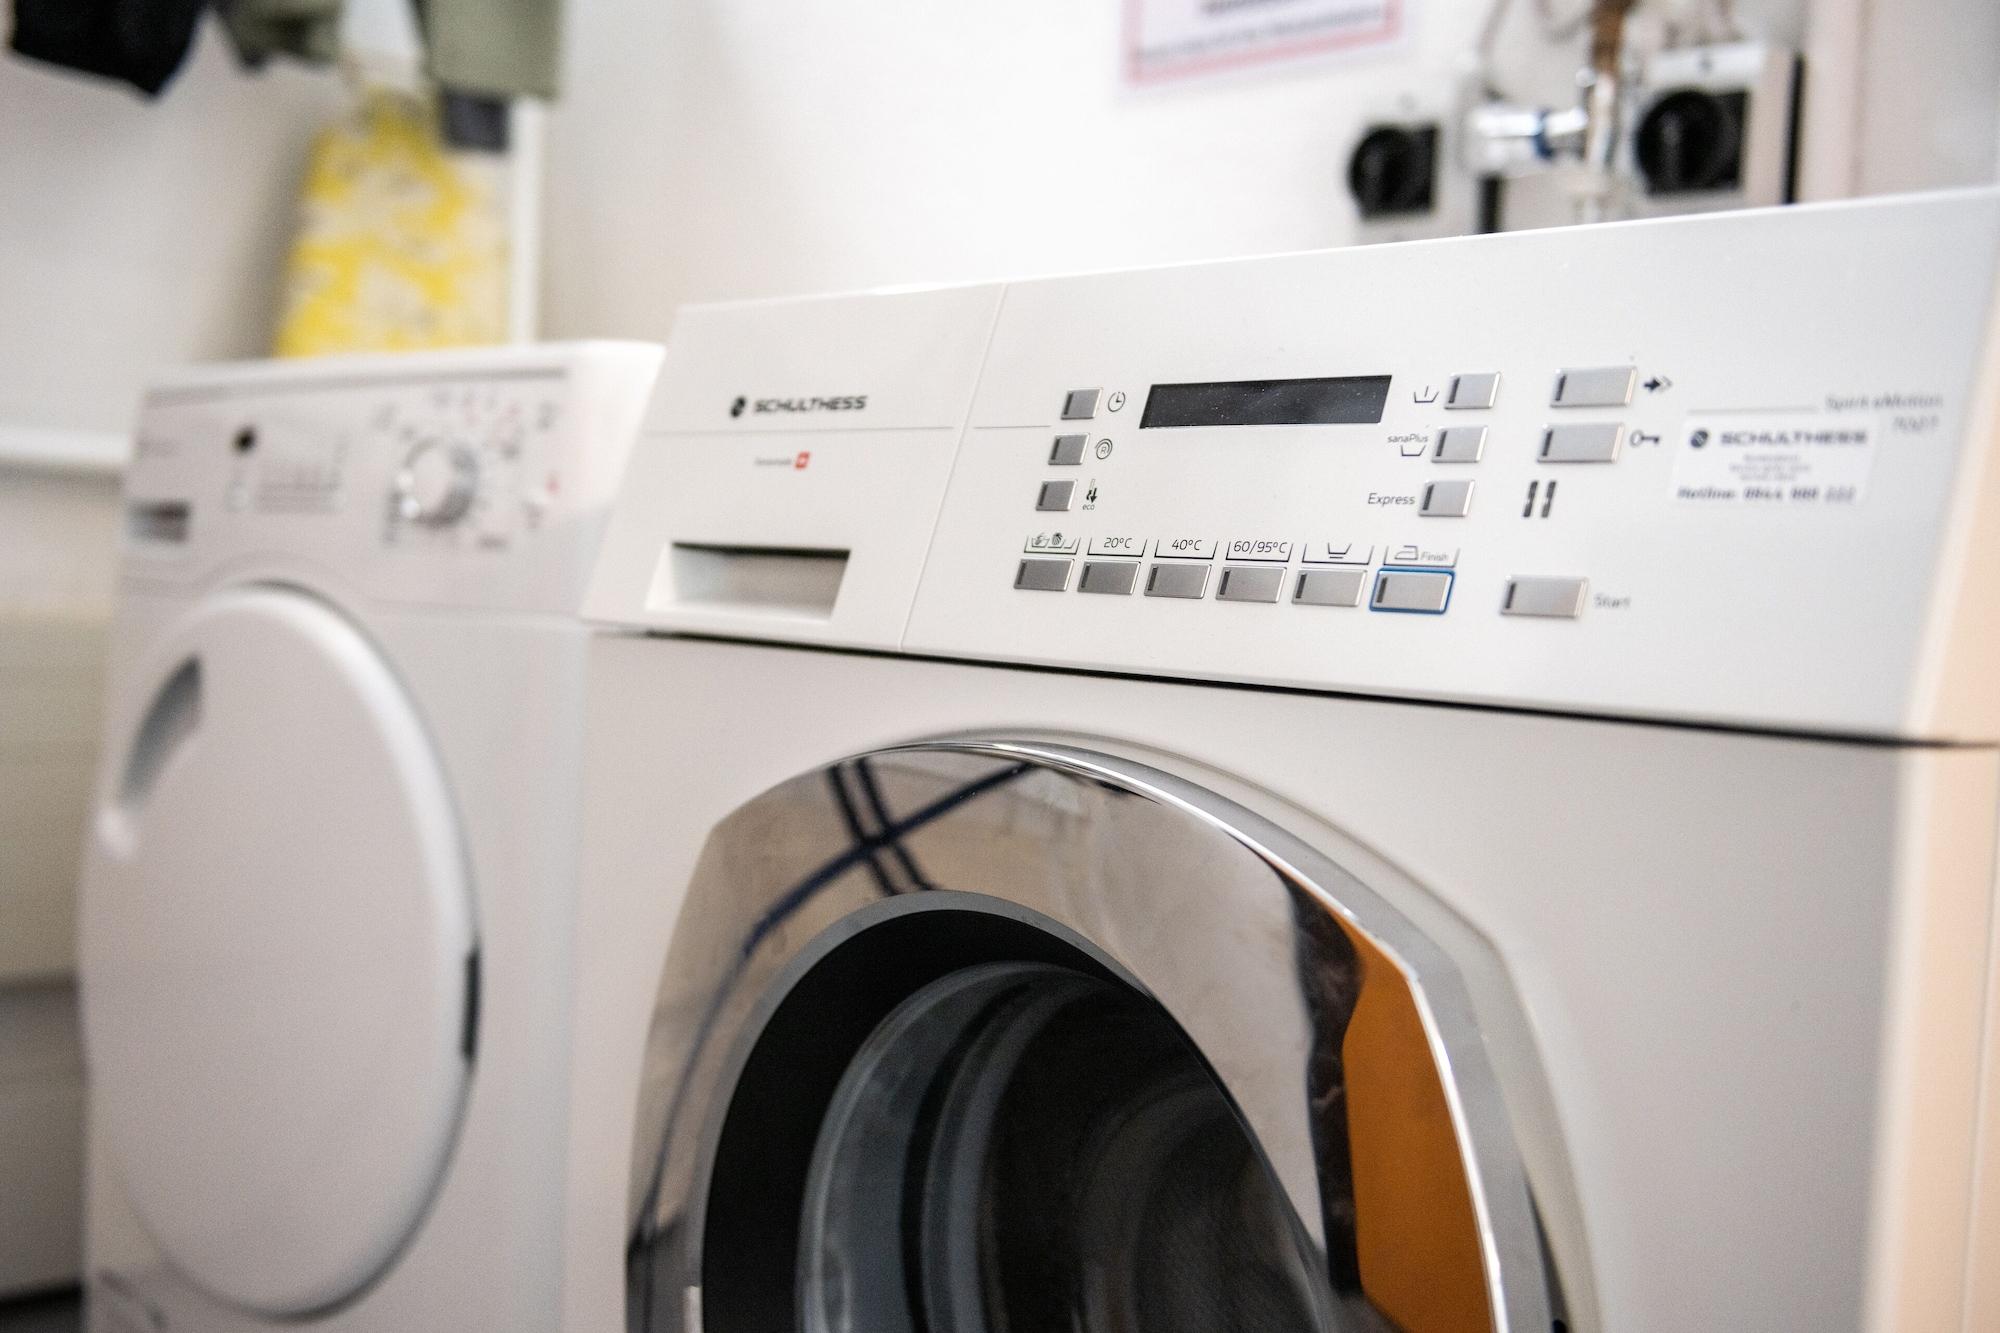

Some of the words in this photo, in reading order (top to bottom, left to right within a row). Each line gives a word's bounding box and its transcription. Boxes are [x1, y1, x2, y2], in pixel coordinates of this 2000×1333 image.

[755, 395, 868, 413] SCHULTHESS
[1387, 433, 1429, 443] sanaPlus
[1720, 430, 1868, 445] SCHULTHESS
[1367, 492, 1416, 507] Express
[1103, 537, 1133, 549] 20°C
[1171, 539, 1203, 551] 40°C
[1233, 541, 1288, 554] 60/95°C
[1420, 551, 1449, 561] Finish
[1594, 593, 1631, 609] Start
